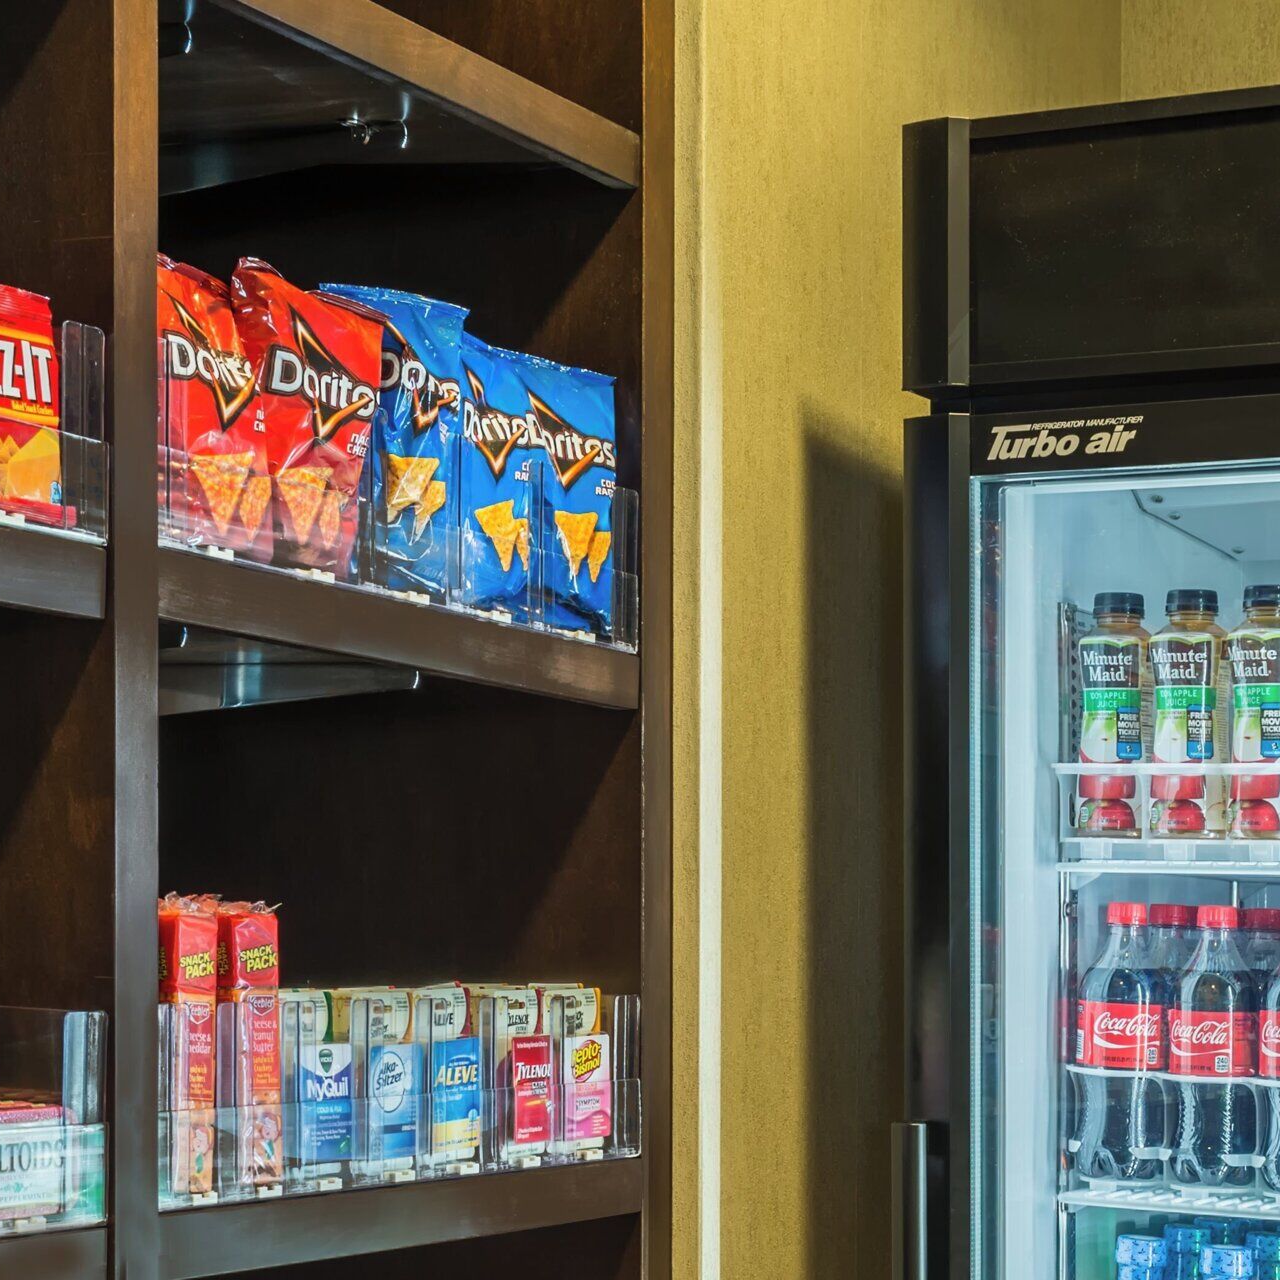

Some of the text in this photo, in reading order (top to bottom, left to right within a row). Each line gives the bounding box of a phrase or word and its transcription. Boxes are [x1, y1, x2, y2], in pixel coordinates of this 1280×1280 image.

[271, 349, 375, 417] Dorito
[1031, 415, 1144, 431] REFRIGERATOR MANUFACTURER
[987, 424, 1137, 461] Turbo air
[1082, 650, 1133, 666] Minute
[1152, 648, 1204, 663] Minute
[1089, 664, 1126, 681] Maid
[1158, 663, 1197, 680] Maid
[1108, 690, 1127, 700] APPLE
[1097, 700, 1117, 708] JUICE
[1119, 713, 1137, 721] FREE
[1118, 728, 1140, 736] TICKET
[180, 952, 210, 968] SNACK
[240, 945, 272, 961] SNACK
[247, 953, 277, 972] PACK
[186, 964, 214, 979] PACK
[1093, 1012, 1160, 1037] Coca-Cola
[435, 1064, 478, 1087] ALEVE
[307, 1076, 348, 1102] NyQuil
